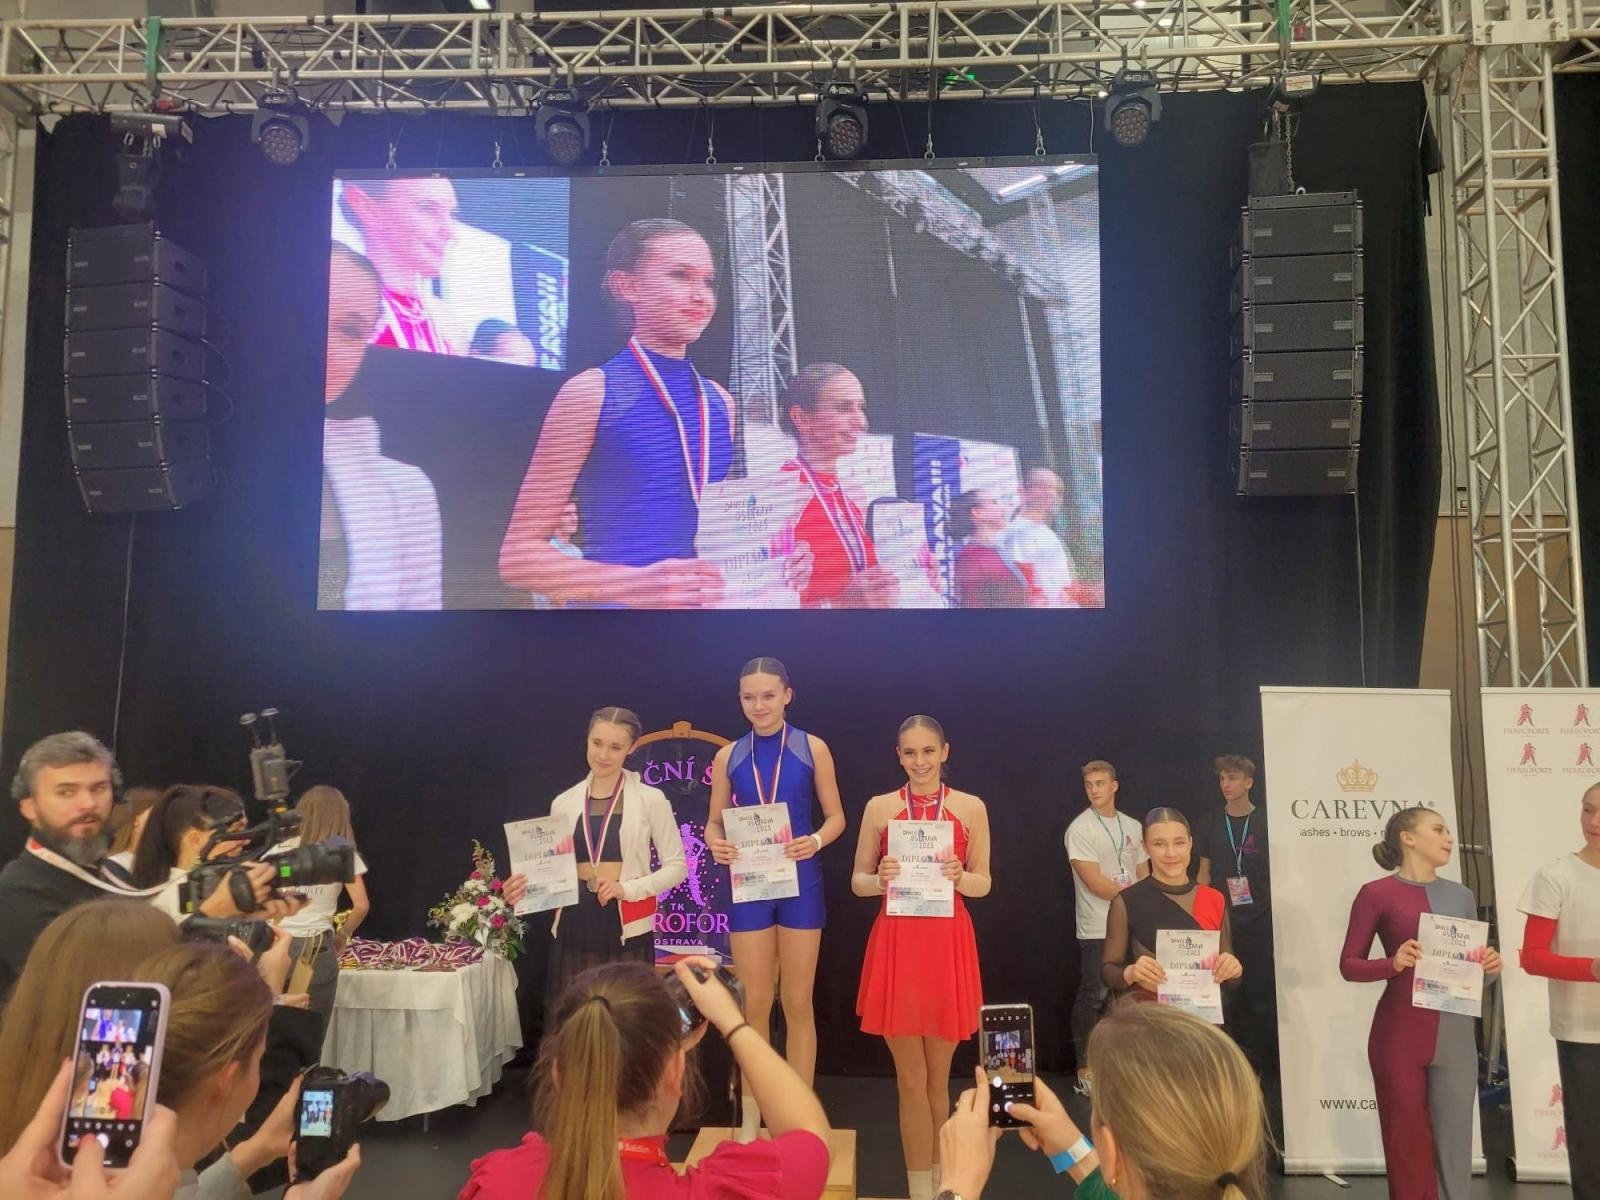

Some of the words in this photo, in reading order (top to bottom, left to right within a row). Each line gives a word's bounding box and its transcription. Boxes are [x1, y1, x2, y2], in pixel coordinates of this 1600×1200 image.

[643, 755, 695, 786] ČNÍ
[1340, 827, 1371, 837] brows
[670, 902, 685, 911] TK
[652, 913, 730, 933] ROFOR
[654, 938, 704, 946] OSTRAVA
[1319, 1099, 1377, 1110] www.ca
